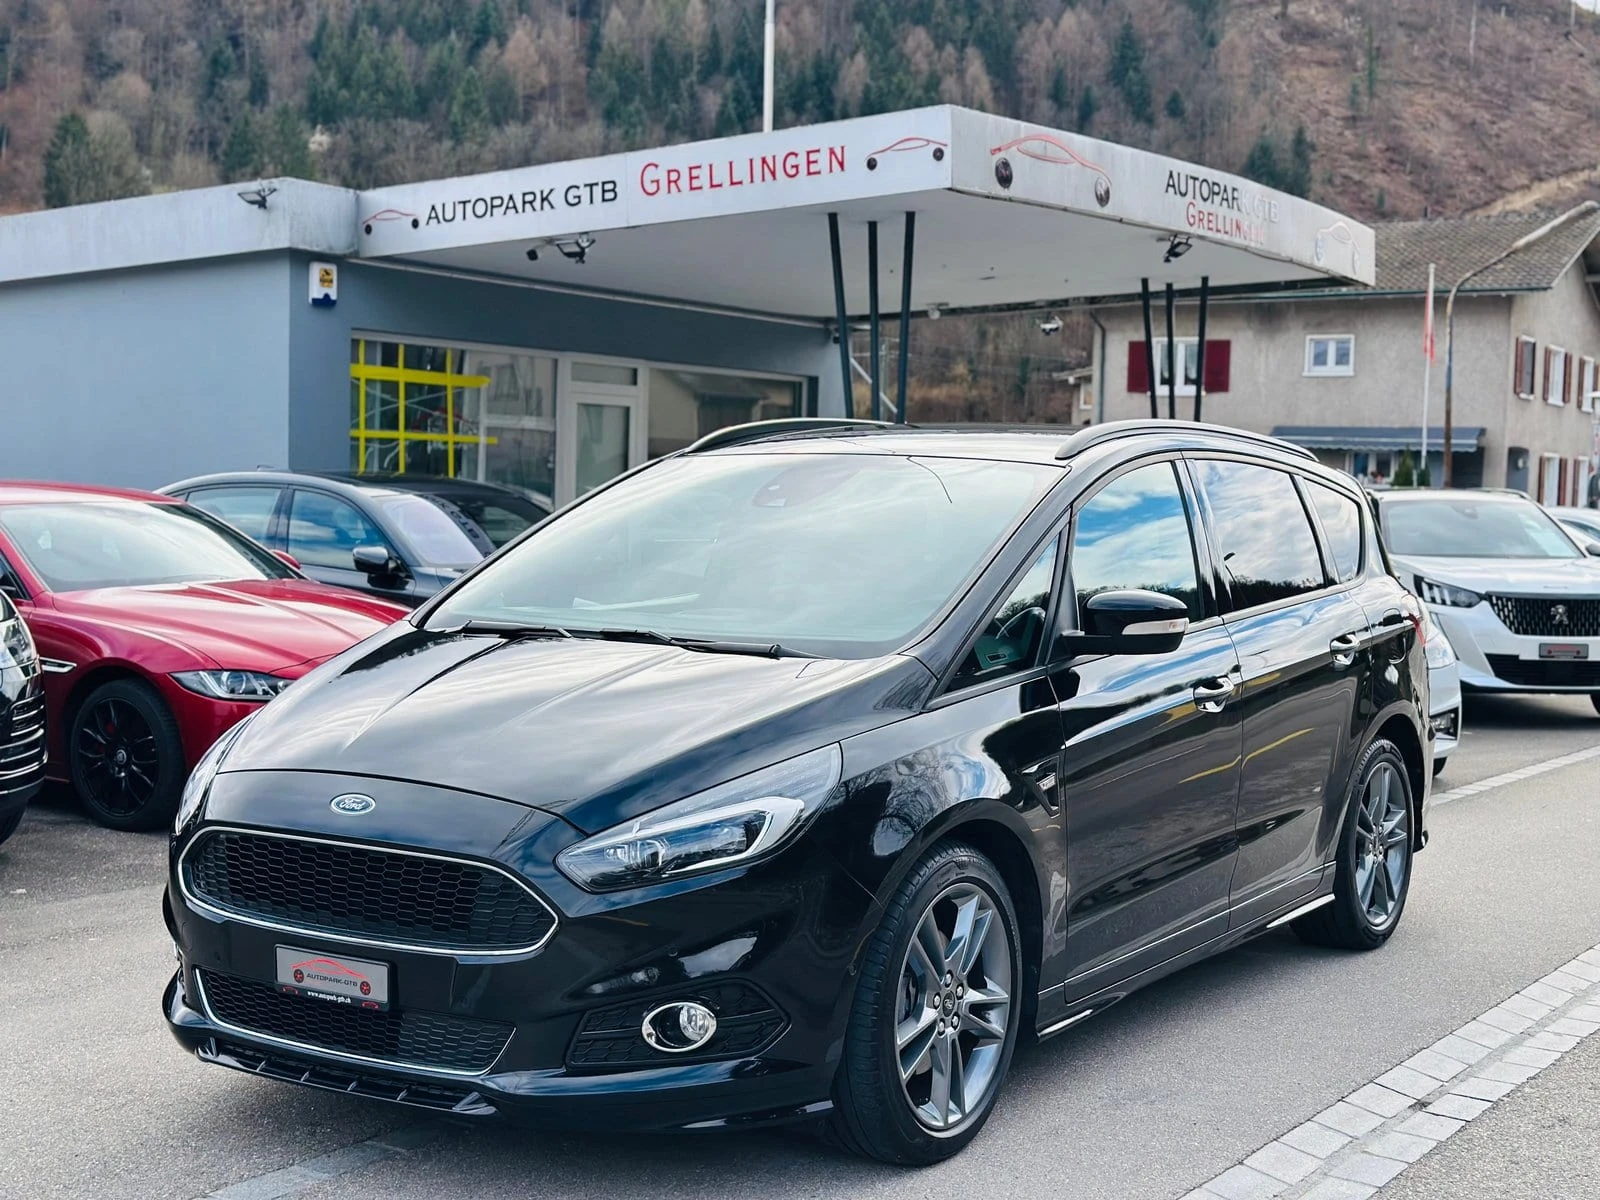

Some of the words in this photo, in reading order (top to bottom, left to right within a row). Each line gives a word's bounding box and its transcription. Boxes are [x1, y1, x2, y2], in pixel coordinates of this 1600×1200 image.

[640, 144, 848, 197] GRELLINGEN
[425, 186, 556, 227] AUTOPARK
[563, 179, 619, 207] GTB
[339, 798, 367, 810] Ford
[306, 973, 358, 987] AUTOPARK-GTB
